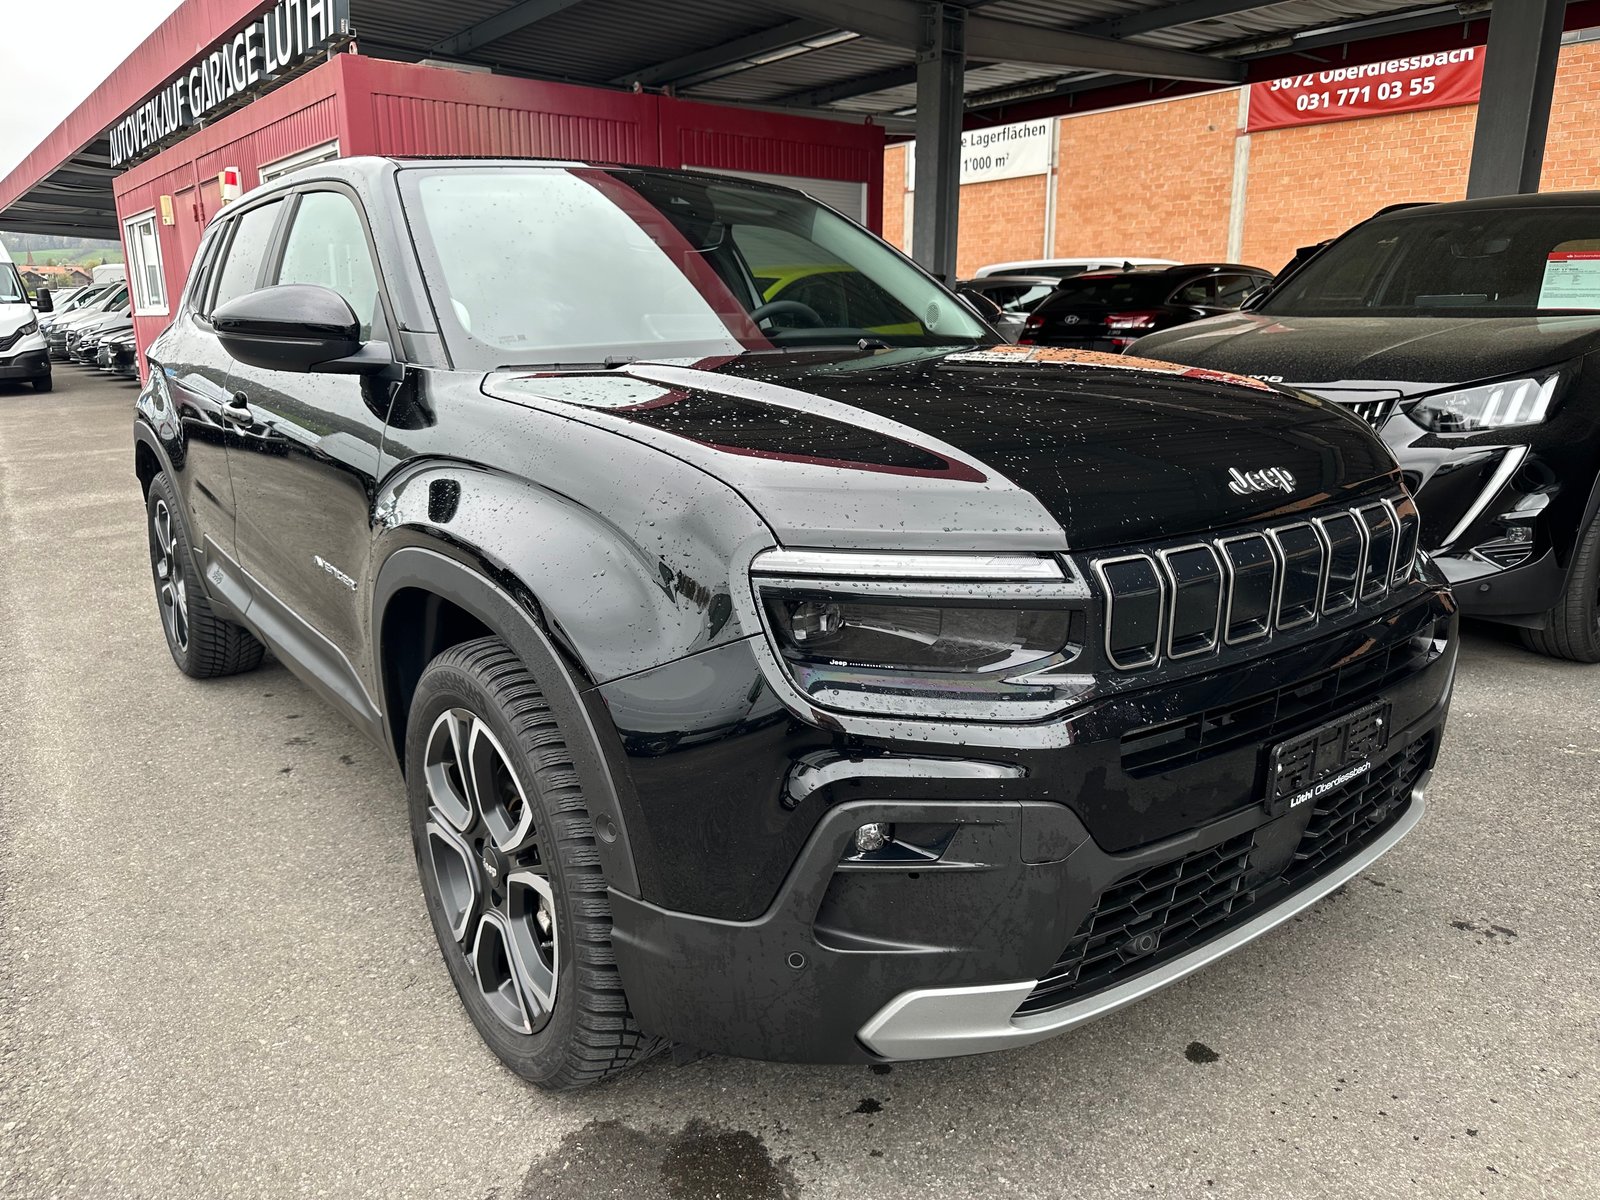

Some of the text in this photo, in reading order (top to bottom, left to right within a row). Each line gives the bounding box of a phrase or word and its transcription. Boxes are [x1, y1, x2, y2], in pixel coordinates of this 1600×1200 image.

[110, 77, 185, 168] AUTOVERKAUF
[187, 24, 259, 118] GARAGE
[1296, 76, 1436, 111] 031 771 03 55
[970, 123, 1046, 148] Lagerflächen
[964, 156, 992, 172] 1'000
[1228, 467, 1297, 495] Jeep
[829, 659, 848, 667] Jeep
[482, 857, 497, 878] Jeep
